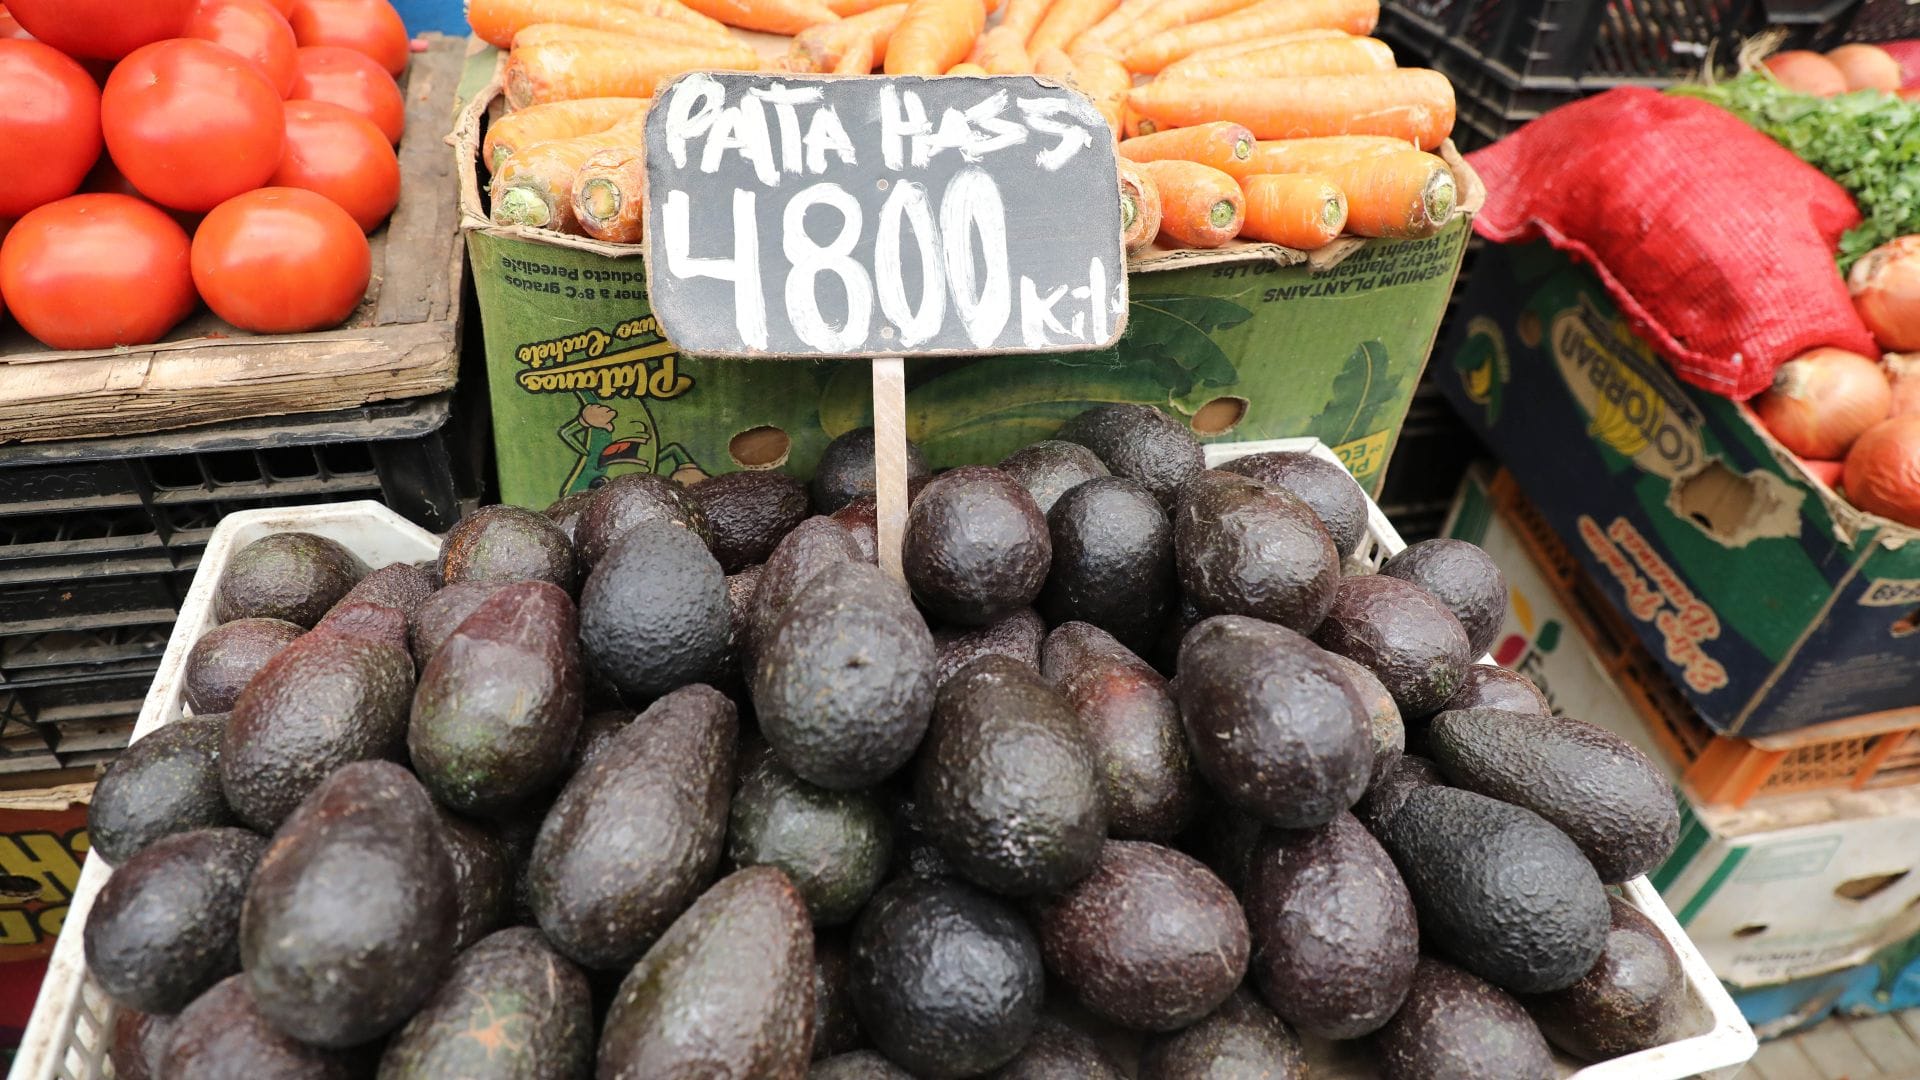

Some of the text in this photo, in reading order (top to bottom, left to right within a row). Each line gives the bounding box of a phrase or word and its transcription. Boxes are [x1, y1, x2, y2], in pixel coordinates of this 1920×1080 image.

[880, 83, 1098, 171] HASS
[662, 165, 1011, 352] 4800
[1377, 235, 1440, 260] Weight
[1401, 247, 1457, 272] ariety:
[502, 257, 645, 285] oducto Perecible
[1212, 264, 1249, 280] Lbs
[504, 275, 561, 296] grados
[600, 289, 610, 300] a
[1263, 278, 1376, 303] PLANTAINS
[518, 330, 610, 368] Cachete
[519, 355, 692, 398] Plátanos
